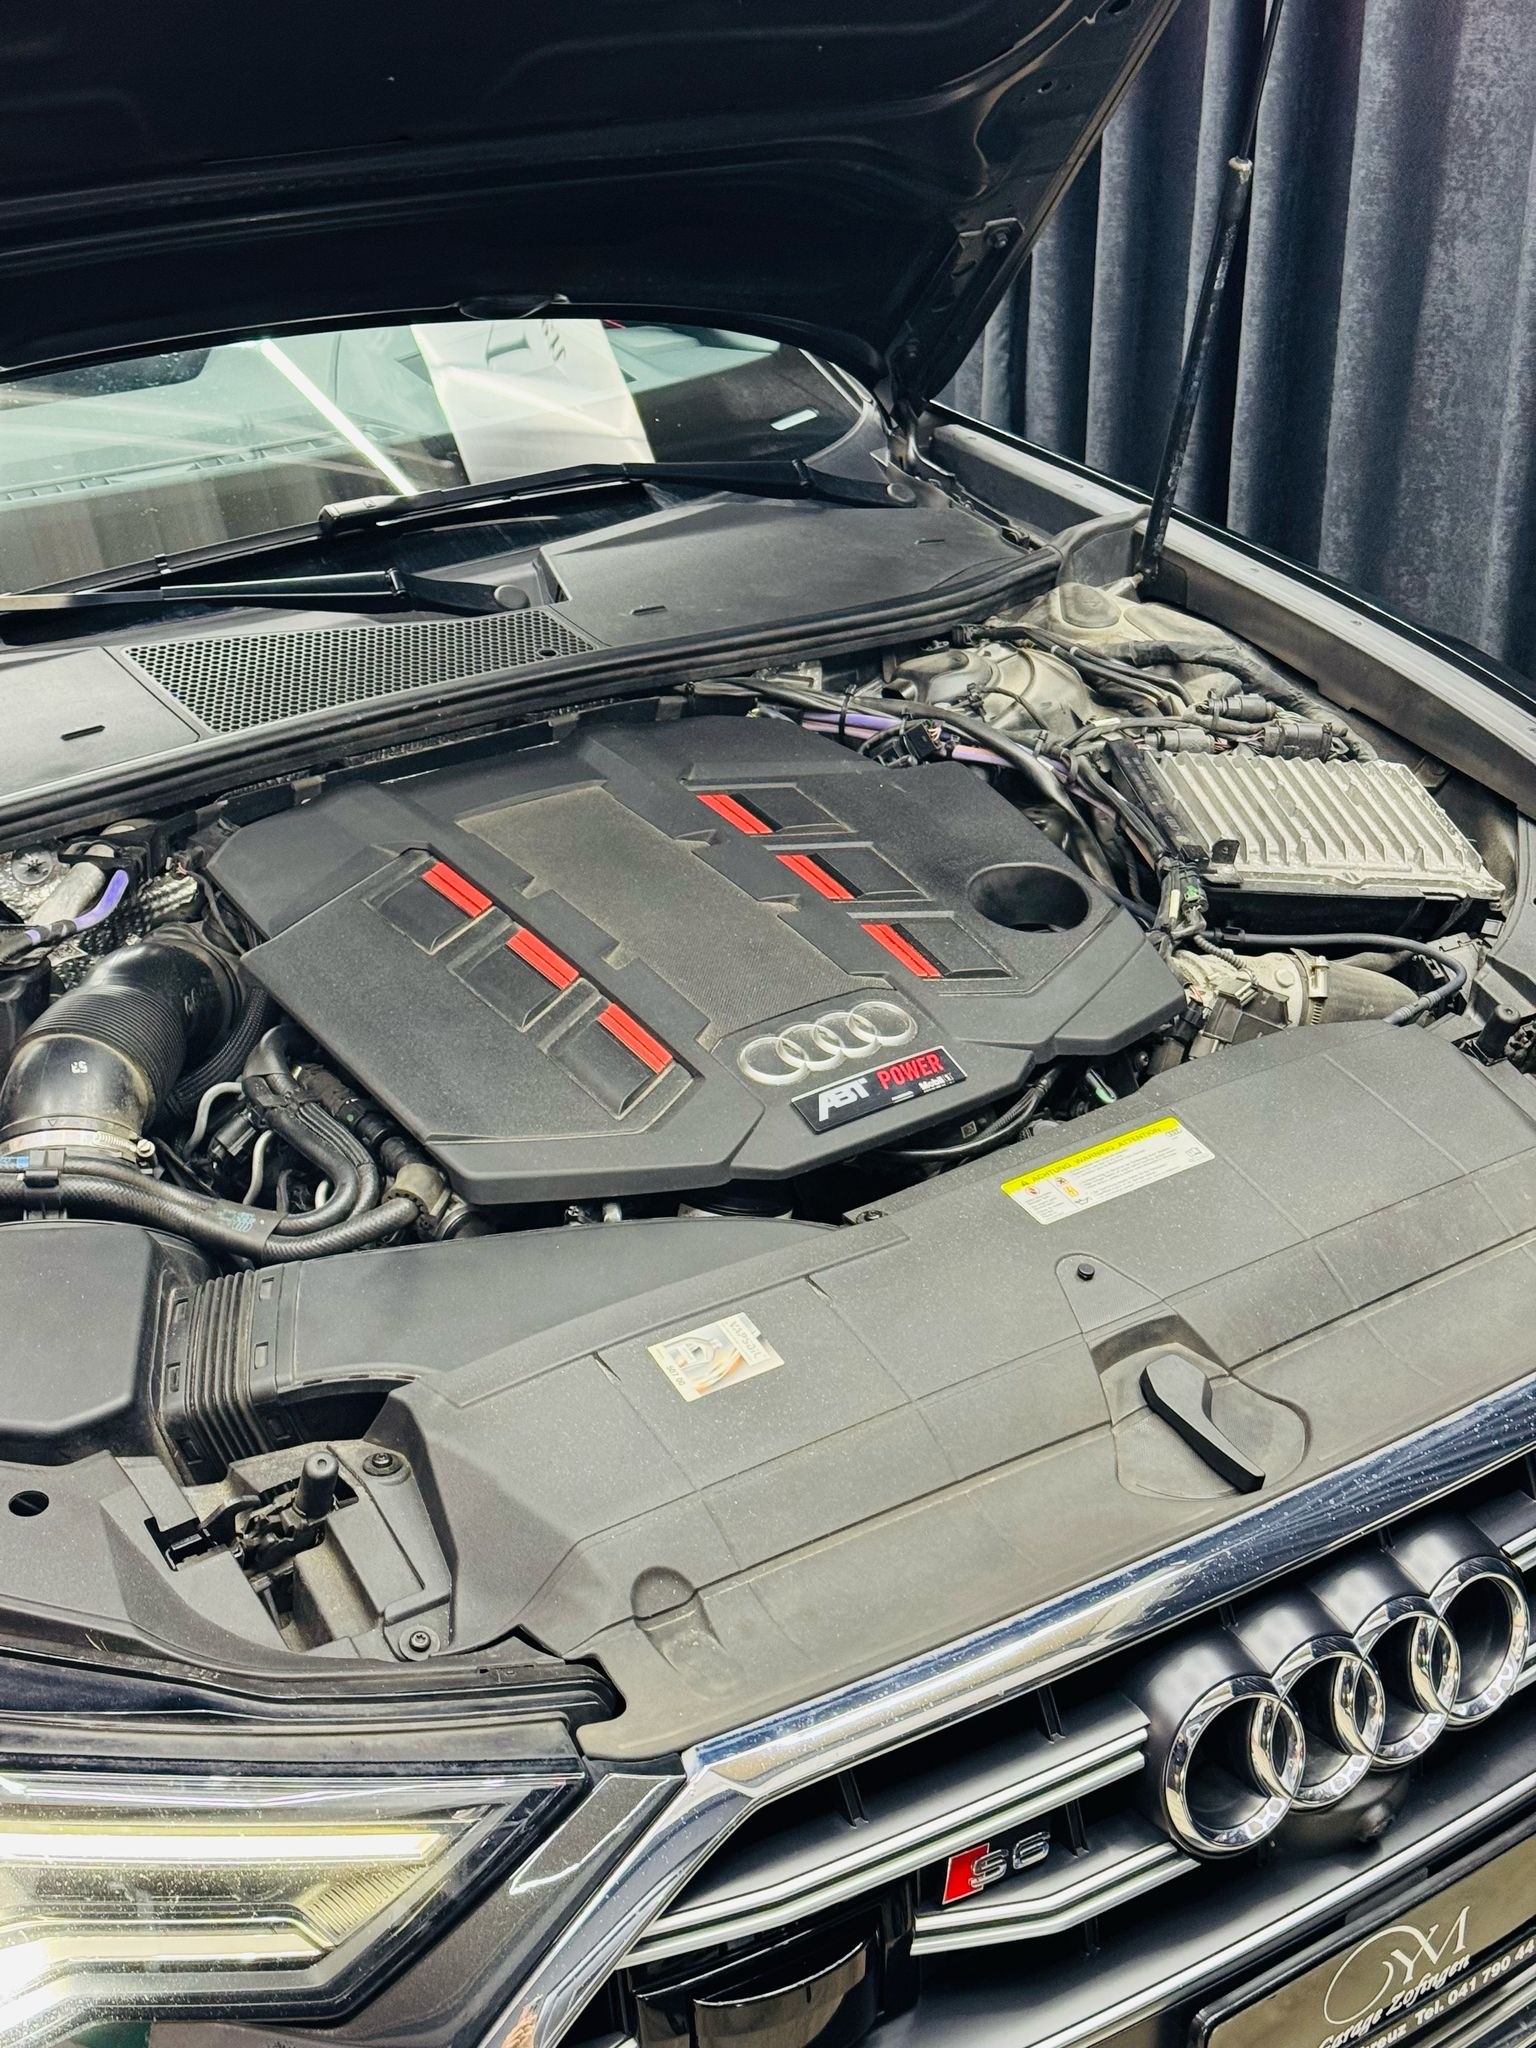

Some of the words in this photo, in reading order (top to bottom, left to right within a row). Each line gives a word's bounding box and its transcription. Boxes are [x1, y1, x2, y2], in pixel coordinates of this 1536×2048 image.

[818, 1077, 871, 1122] ABT
[876, 1052, 945, 1090] POWER
[1075, 1144, 1116, 1166] WARNING
[1117, 1127, 1163, 1147] ATTENTION
[967, 1830, 1052, 1889] S6
[1318, 2007, 1384, 2048] Garage
[1385, 1953, 1471, 2017] Zofingen
[1414, 2001, 1445, 2026] Tel.
[1447, 1976, 1477, 2004] 041
[1481, 1955, 1511, 1984] 790
[1514, 1938, 1535, 1961] 44
